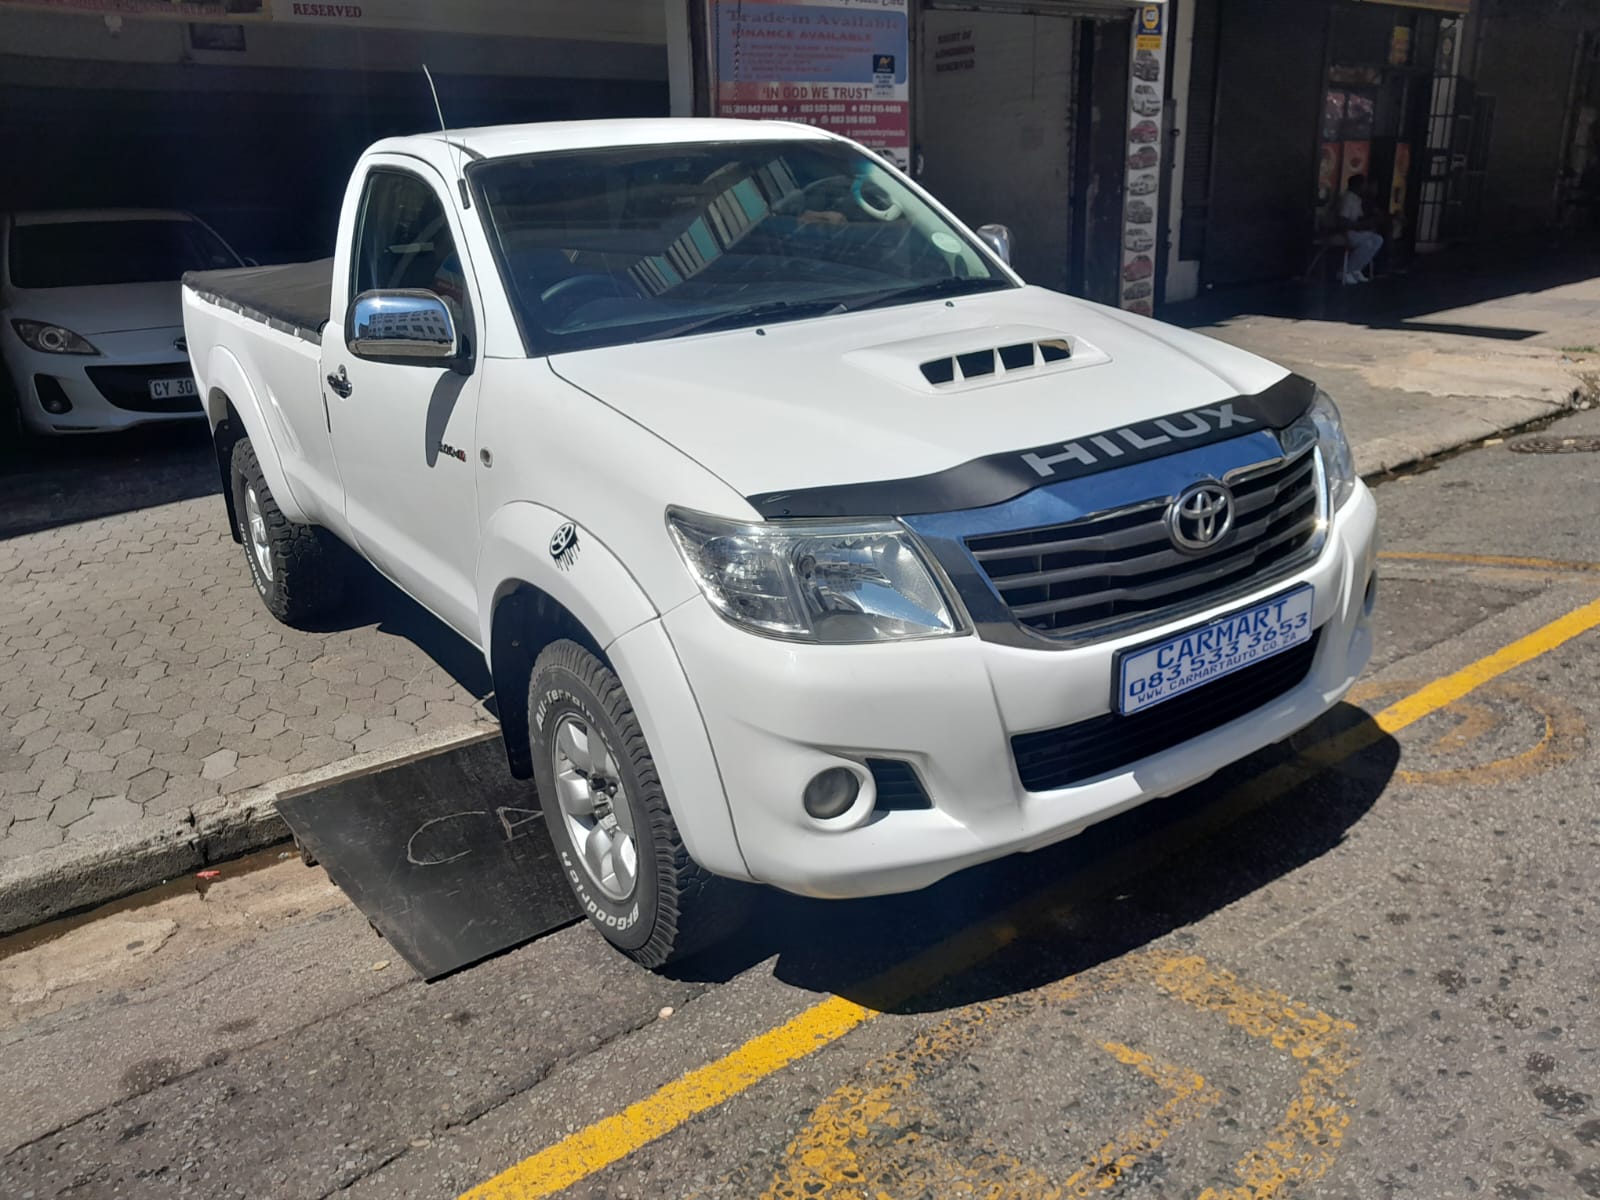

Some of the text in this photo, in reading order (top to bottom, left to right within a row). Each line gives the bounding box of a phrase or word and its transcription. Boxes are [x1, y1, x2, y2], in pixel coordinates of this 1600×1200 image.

[292, 3, 362, 18] RESERVED
[727, 10, 899, 30] Trade-in Available
[731, 29, 873, 42] FINANCE AVAILABLE
[783, 87, 809, 99] GOD
[811, 87, 830, 99] WE
[154, 380, 193, 396] CY 30
[1021, 403, 1257, 478] HILUX
[1157, 600, 1288, 670] CARMART
[1129, 612, 1308, 697] 083 533 3653
